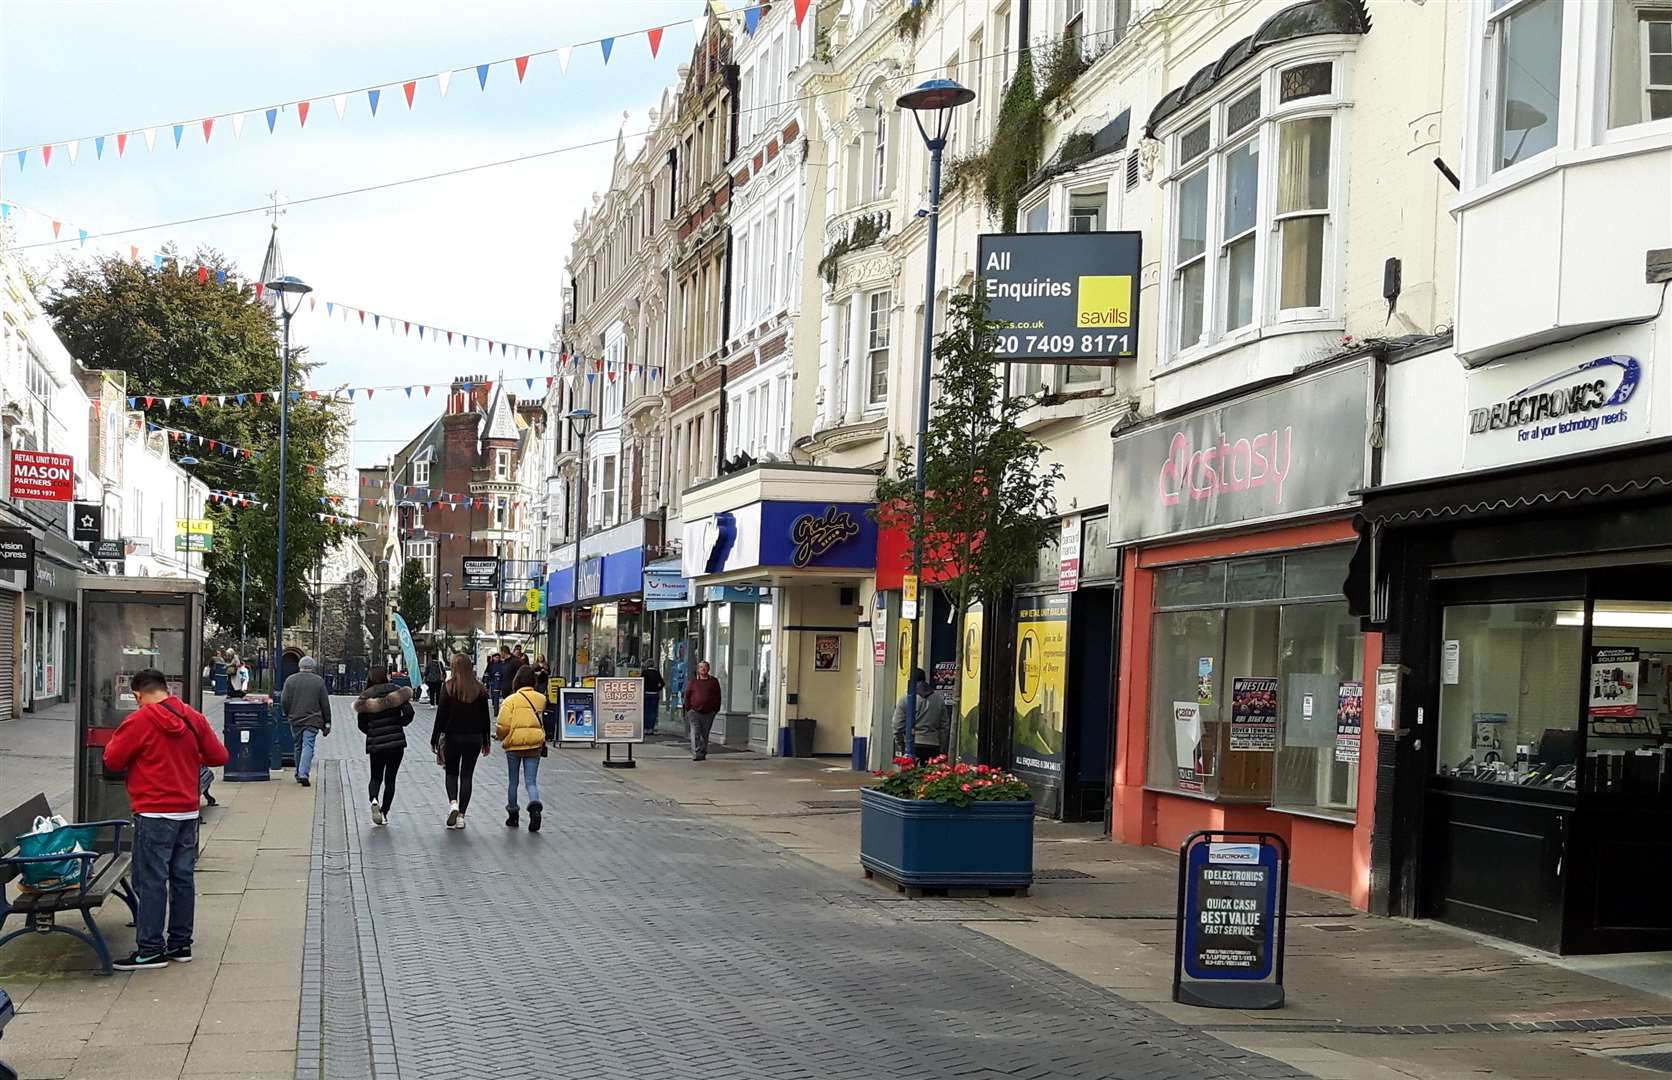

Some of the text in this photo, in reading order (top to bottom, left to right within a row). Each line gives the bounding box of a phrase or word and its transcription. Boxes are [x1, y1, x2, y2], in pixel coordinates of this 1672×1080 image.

[986, 252, 1010, 271] All
[986, 278, 1072, 302] Enquiries
[1080, 308, 1128, 325] savills
[1025, 335, 1074, 353] 7409
[1081, 335, 1130, 352] 8171
[1490, 379, 1606, 430] ELECTRONICS
[1518, 409, 1628, 442] For all your technology needs
[15, 454, 70, 466] RETAIL UNIT TO LET
[15, 464, 70, 480] MASON
[192, 522, 209, 530] LET
[792, 505, 859, 568] Gala
[0, 542, 23, 550] vision
[604, 682, 636, 692] FREE
[605, 692, 634, 700] BINGO
[1204, 870, 1264, 881] TD ELECTRONICS
[1206, 898, 1257, 911] QUICK CASH
[1201, 911, 1260, 925] BEST VALUE
[1205, 925, 1254, 936] FAST SERVICE
